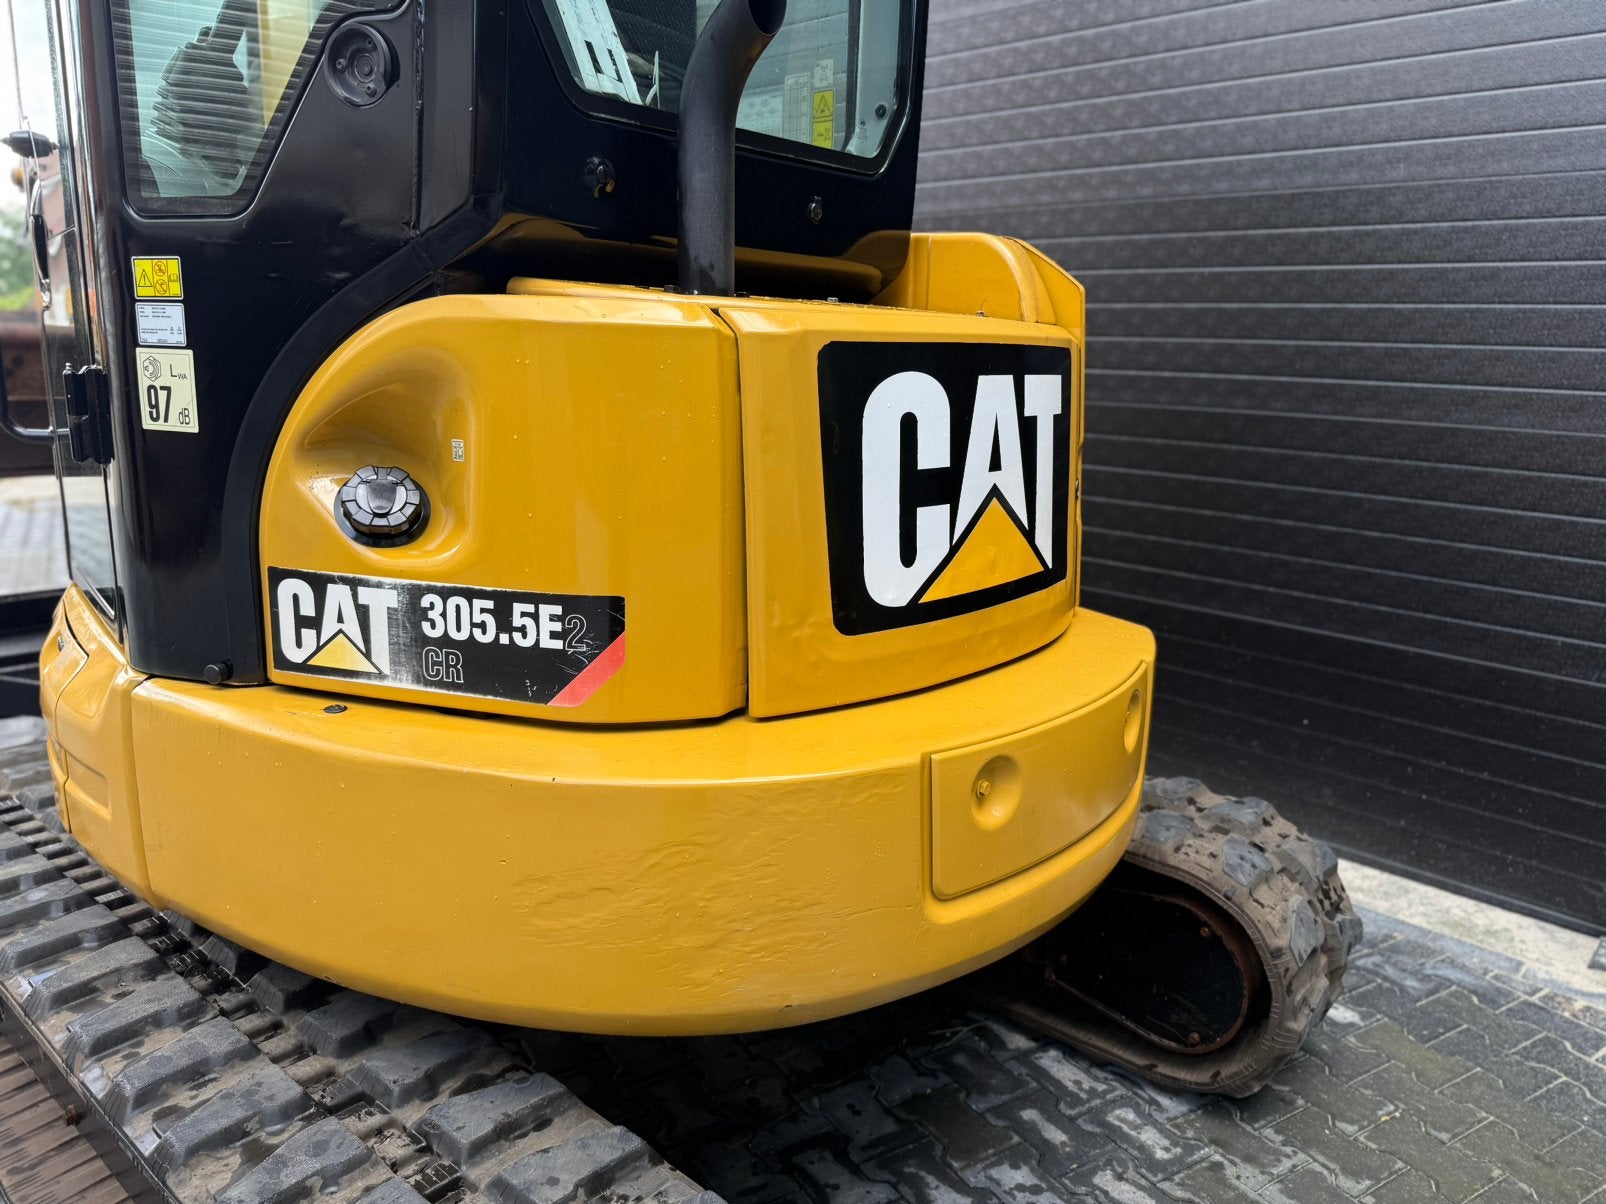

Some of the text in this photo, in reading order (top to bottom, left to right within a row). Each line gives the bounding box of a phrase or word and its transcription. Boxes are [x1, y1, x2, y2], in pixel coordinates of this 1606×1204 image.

[146, 385, 172, 423] 97
[179, 407, 192, 425] dB
[862, 371, 1062, 607] CAT
[277, 578, 398, 675] CAT
[423, 647, 465, 684] CR
